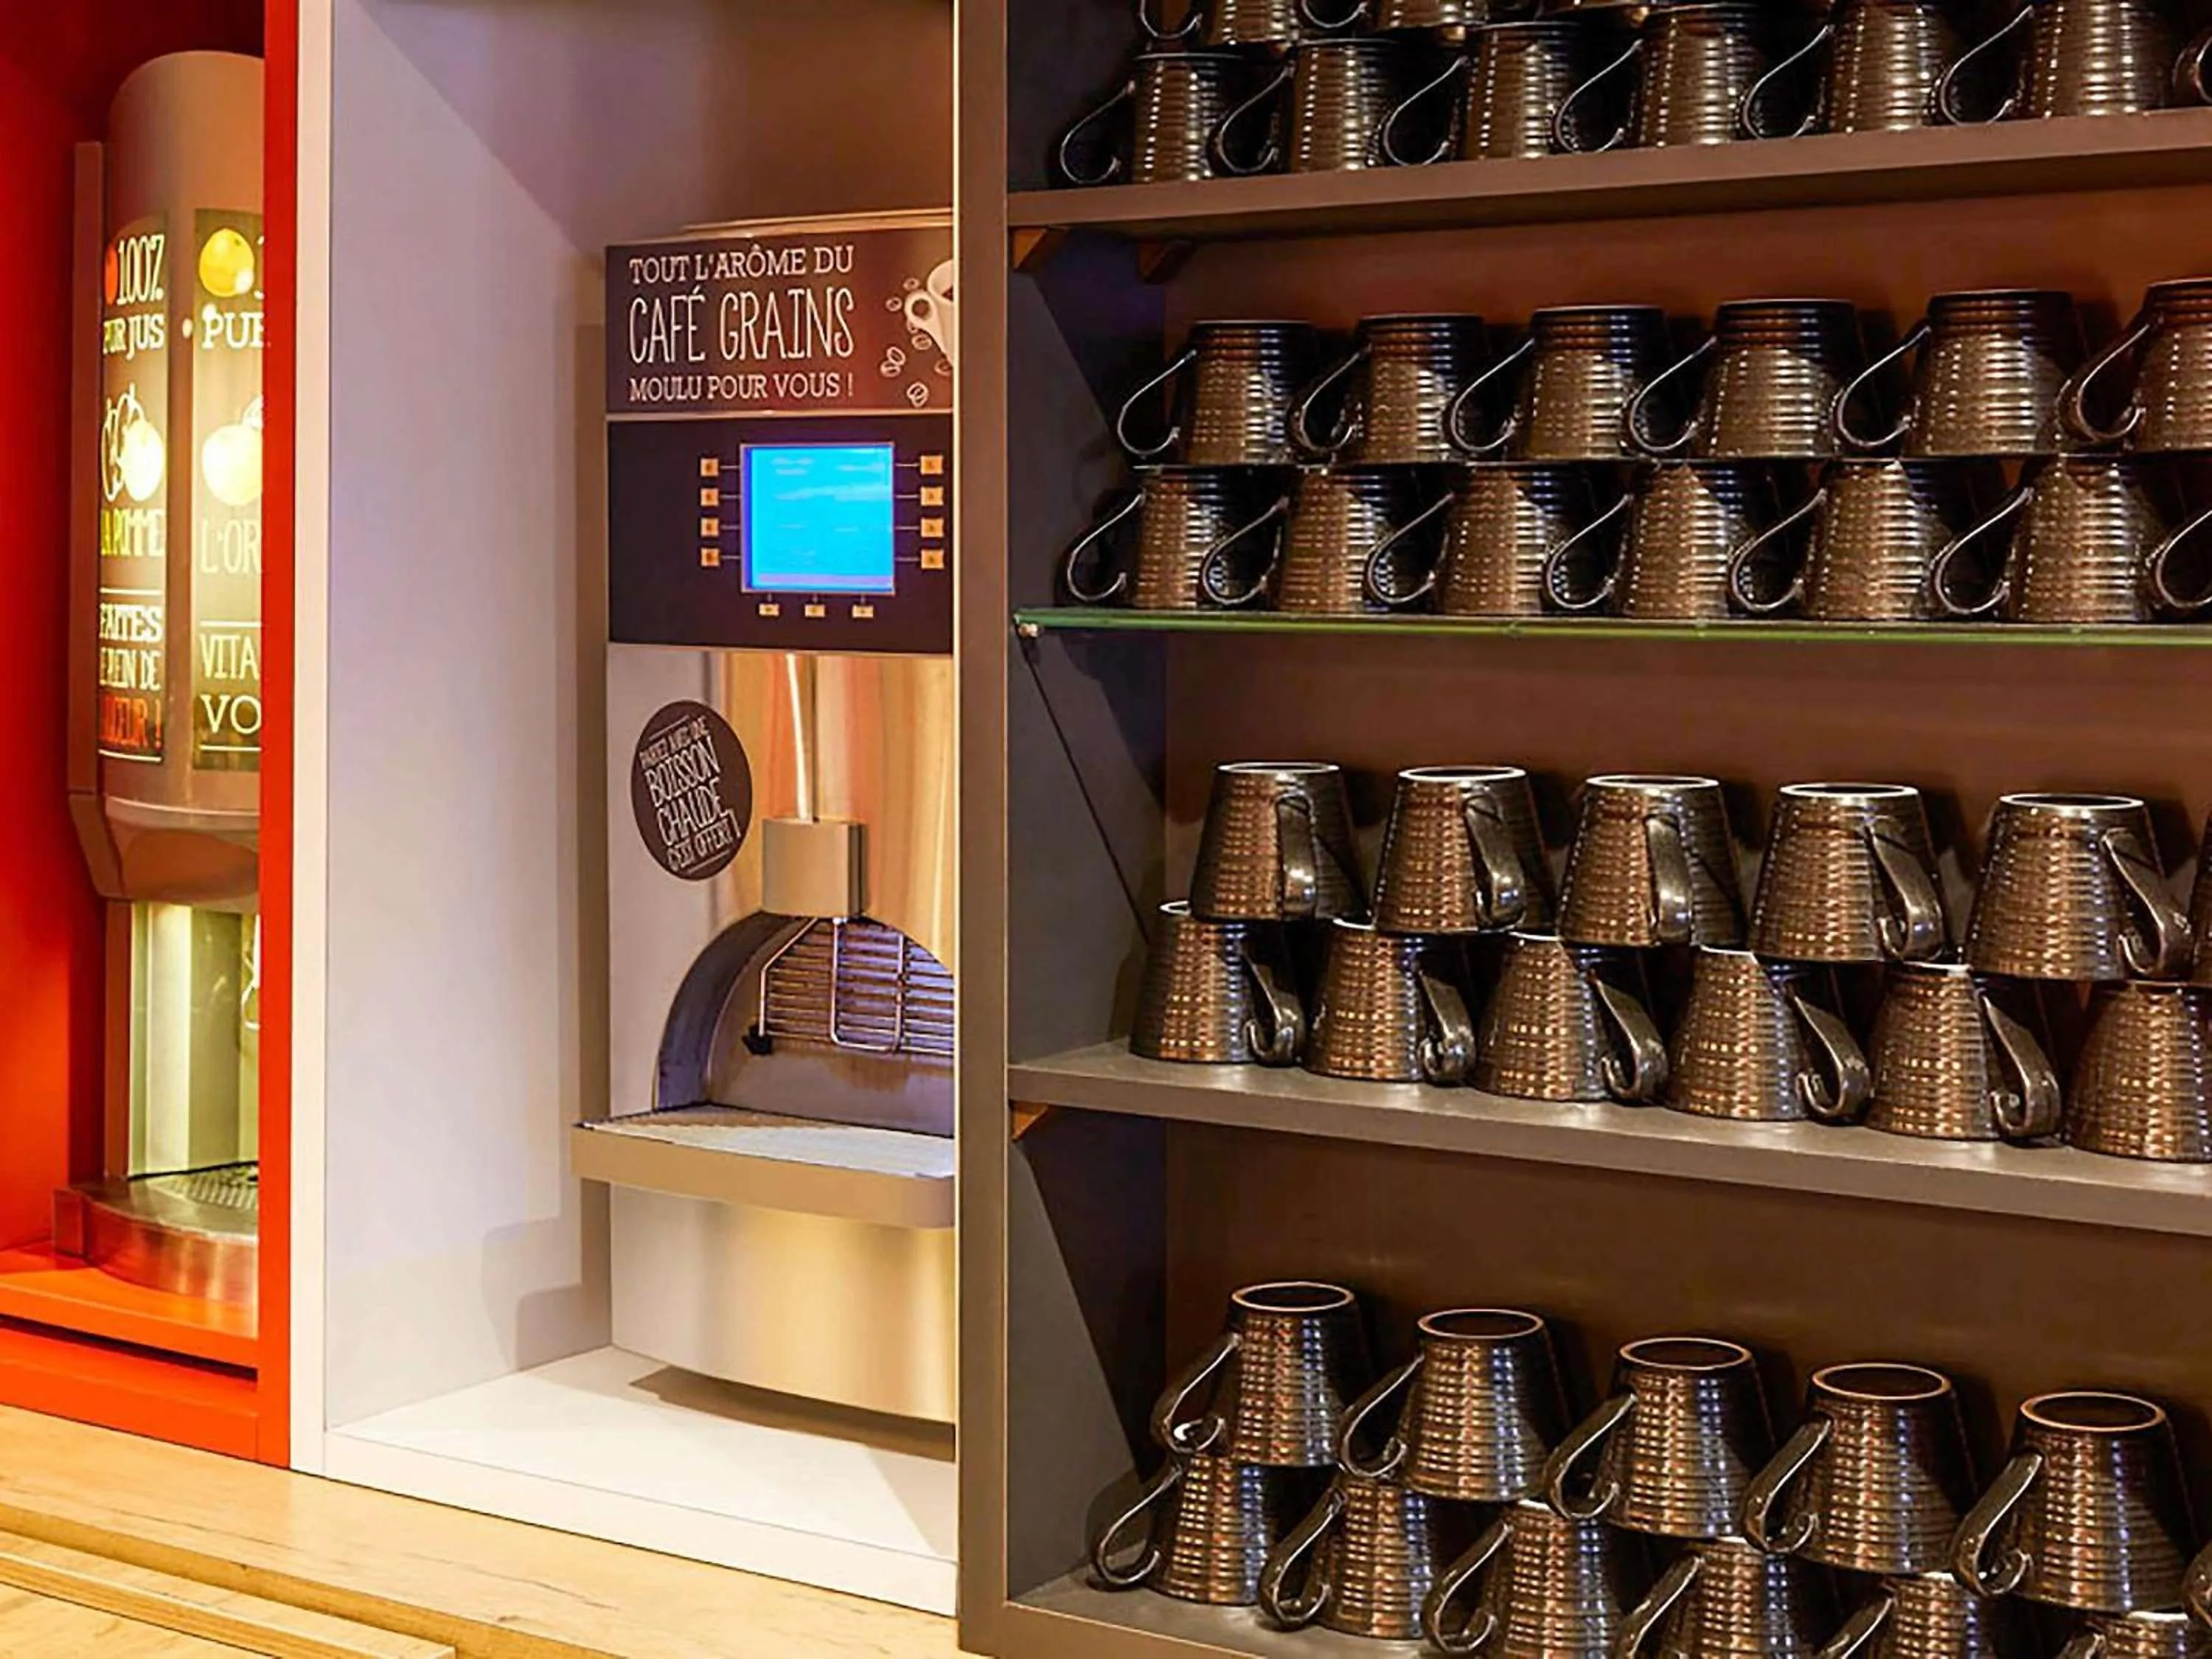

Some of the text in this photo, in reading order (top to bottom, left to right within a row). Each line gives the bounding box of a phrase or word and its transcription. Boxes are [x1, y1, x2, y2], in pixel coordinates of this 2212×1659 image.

[630, 244, 854, 284] TOUT L'ARÔME DU
[127, 313, 164, 360] JUS
[629, 285, 855, 363] CAFÉ GRAINS
[630, 377, 701, 402] MOULU
[708, 375, 768, 400] POUR
[773, 373, 840, 398] VOUS
[644, 736, 720, 807] BOISSON
[657, 776, 725, 846] CHAUDE
